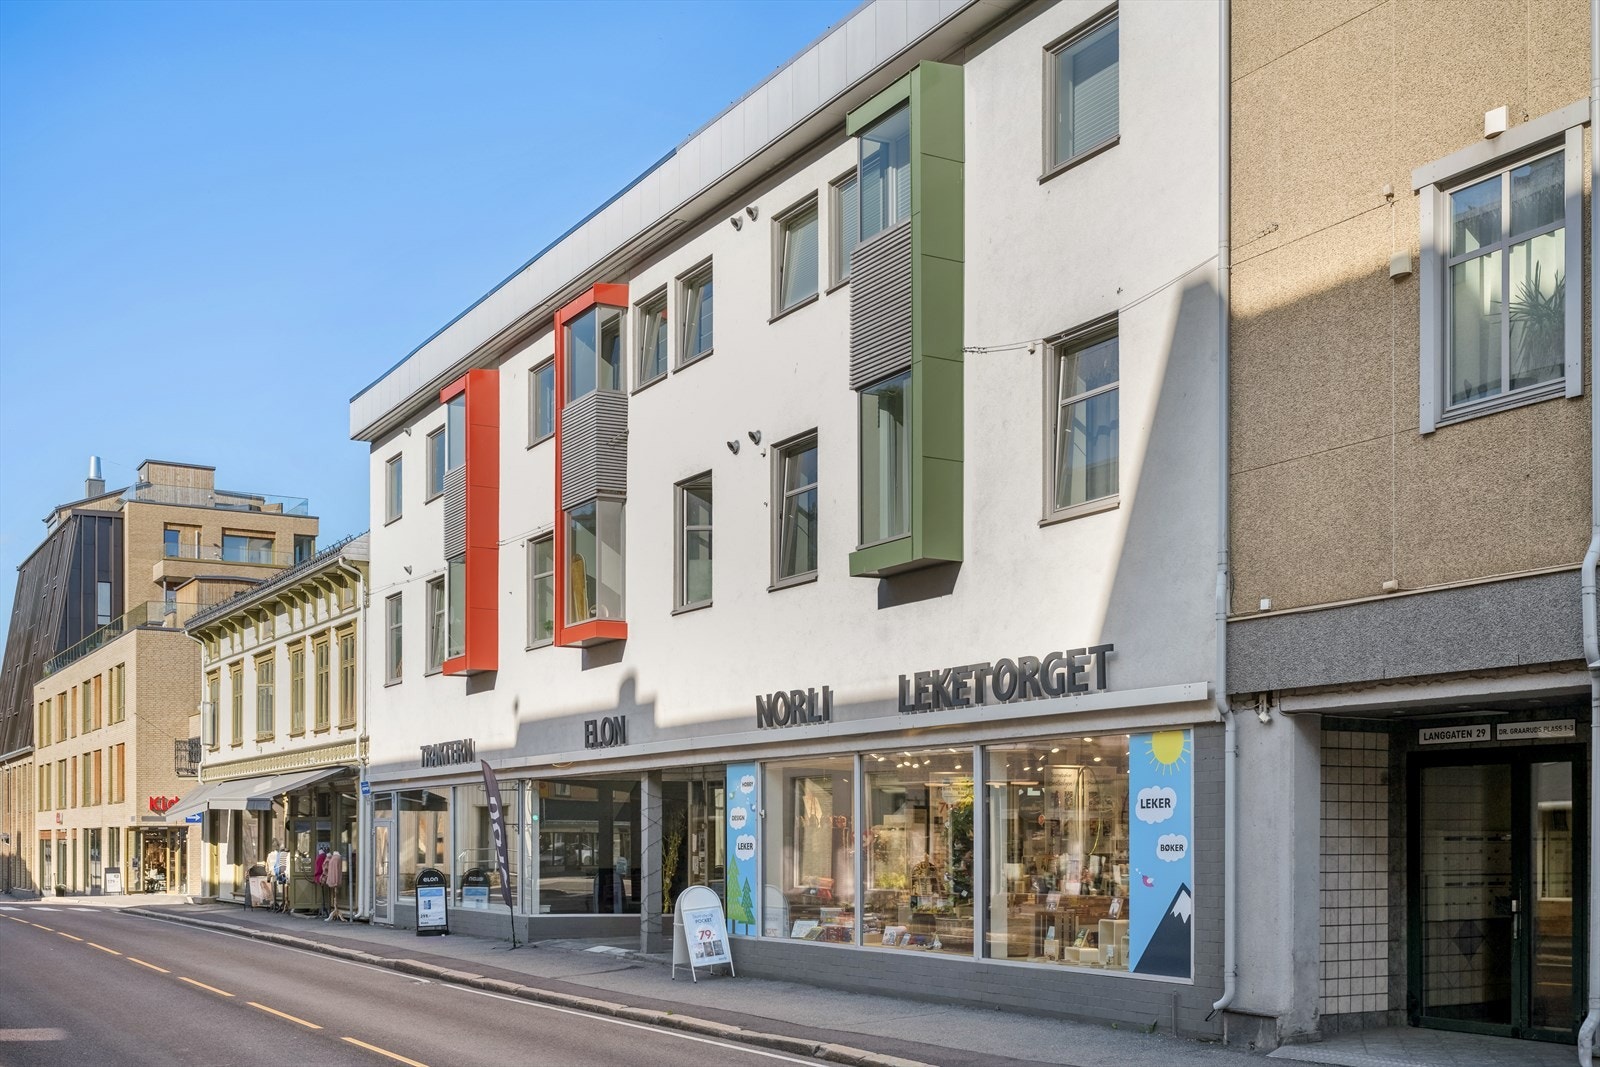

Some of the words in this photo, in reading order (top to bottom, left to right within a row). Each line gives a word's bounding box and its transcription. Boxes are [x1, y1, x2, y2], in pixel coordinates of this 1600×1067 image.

[898, 643, 1114, 713] LEKETORGET
[755, 685, 830, 729] NORLI
[584, 715, 626, 748] ELON
[1423, 729, 1473, 741] LANGGATEN
[1476, 728, 1486, 738] 29
[1543, 725, 1562, 733] PLASS
[1140, 797, 1171, 809] LEKER
[737, 842, 754, 851] LEKER
[1160, 844, 1184, 852] BØKER
[698, 929, 716, 941] 79,-
